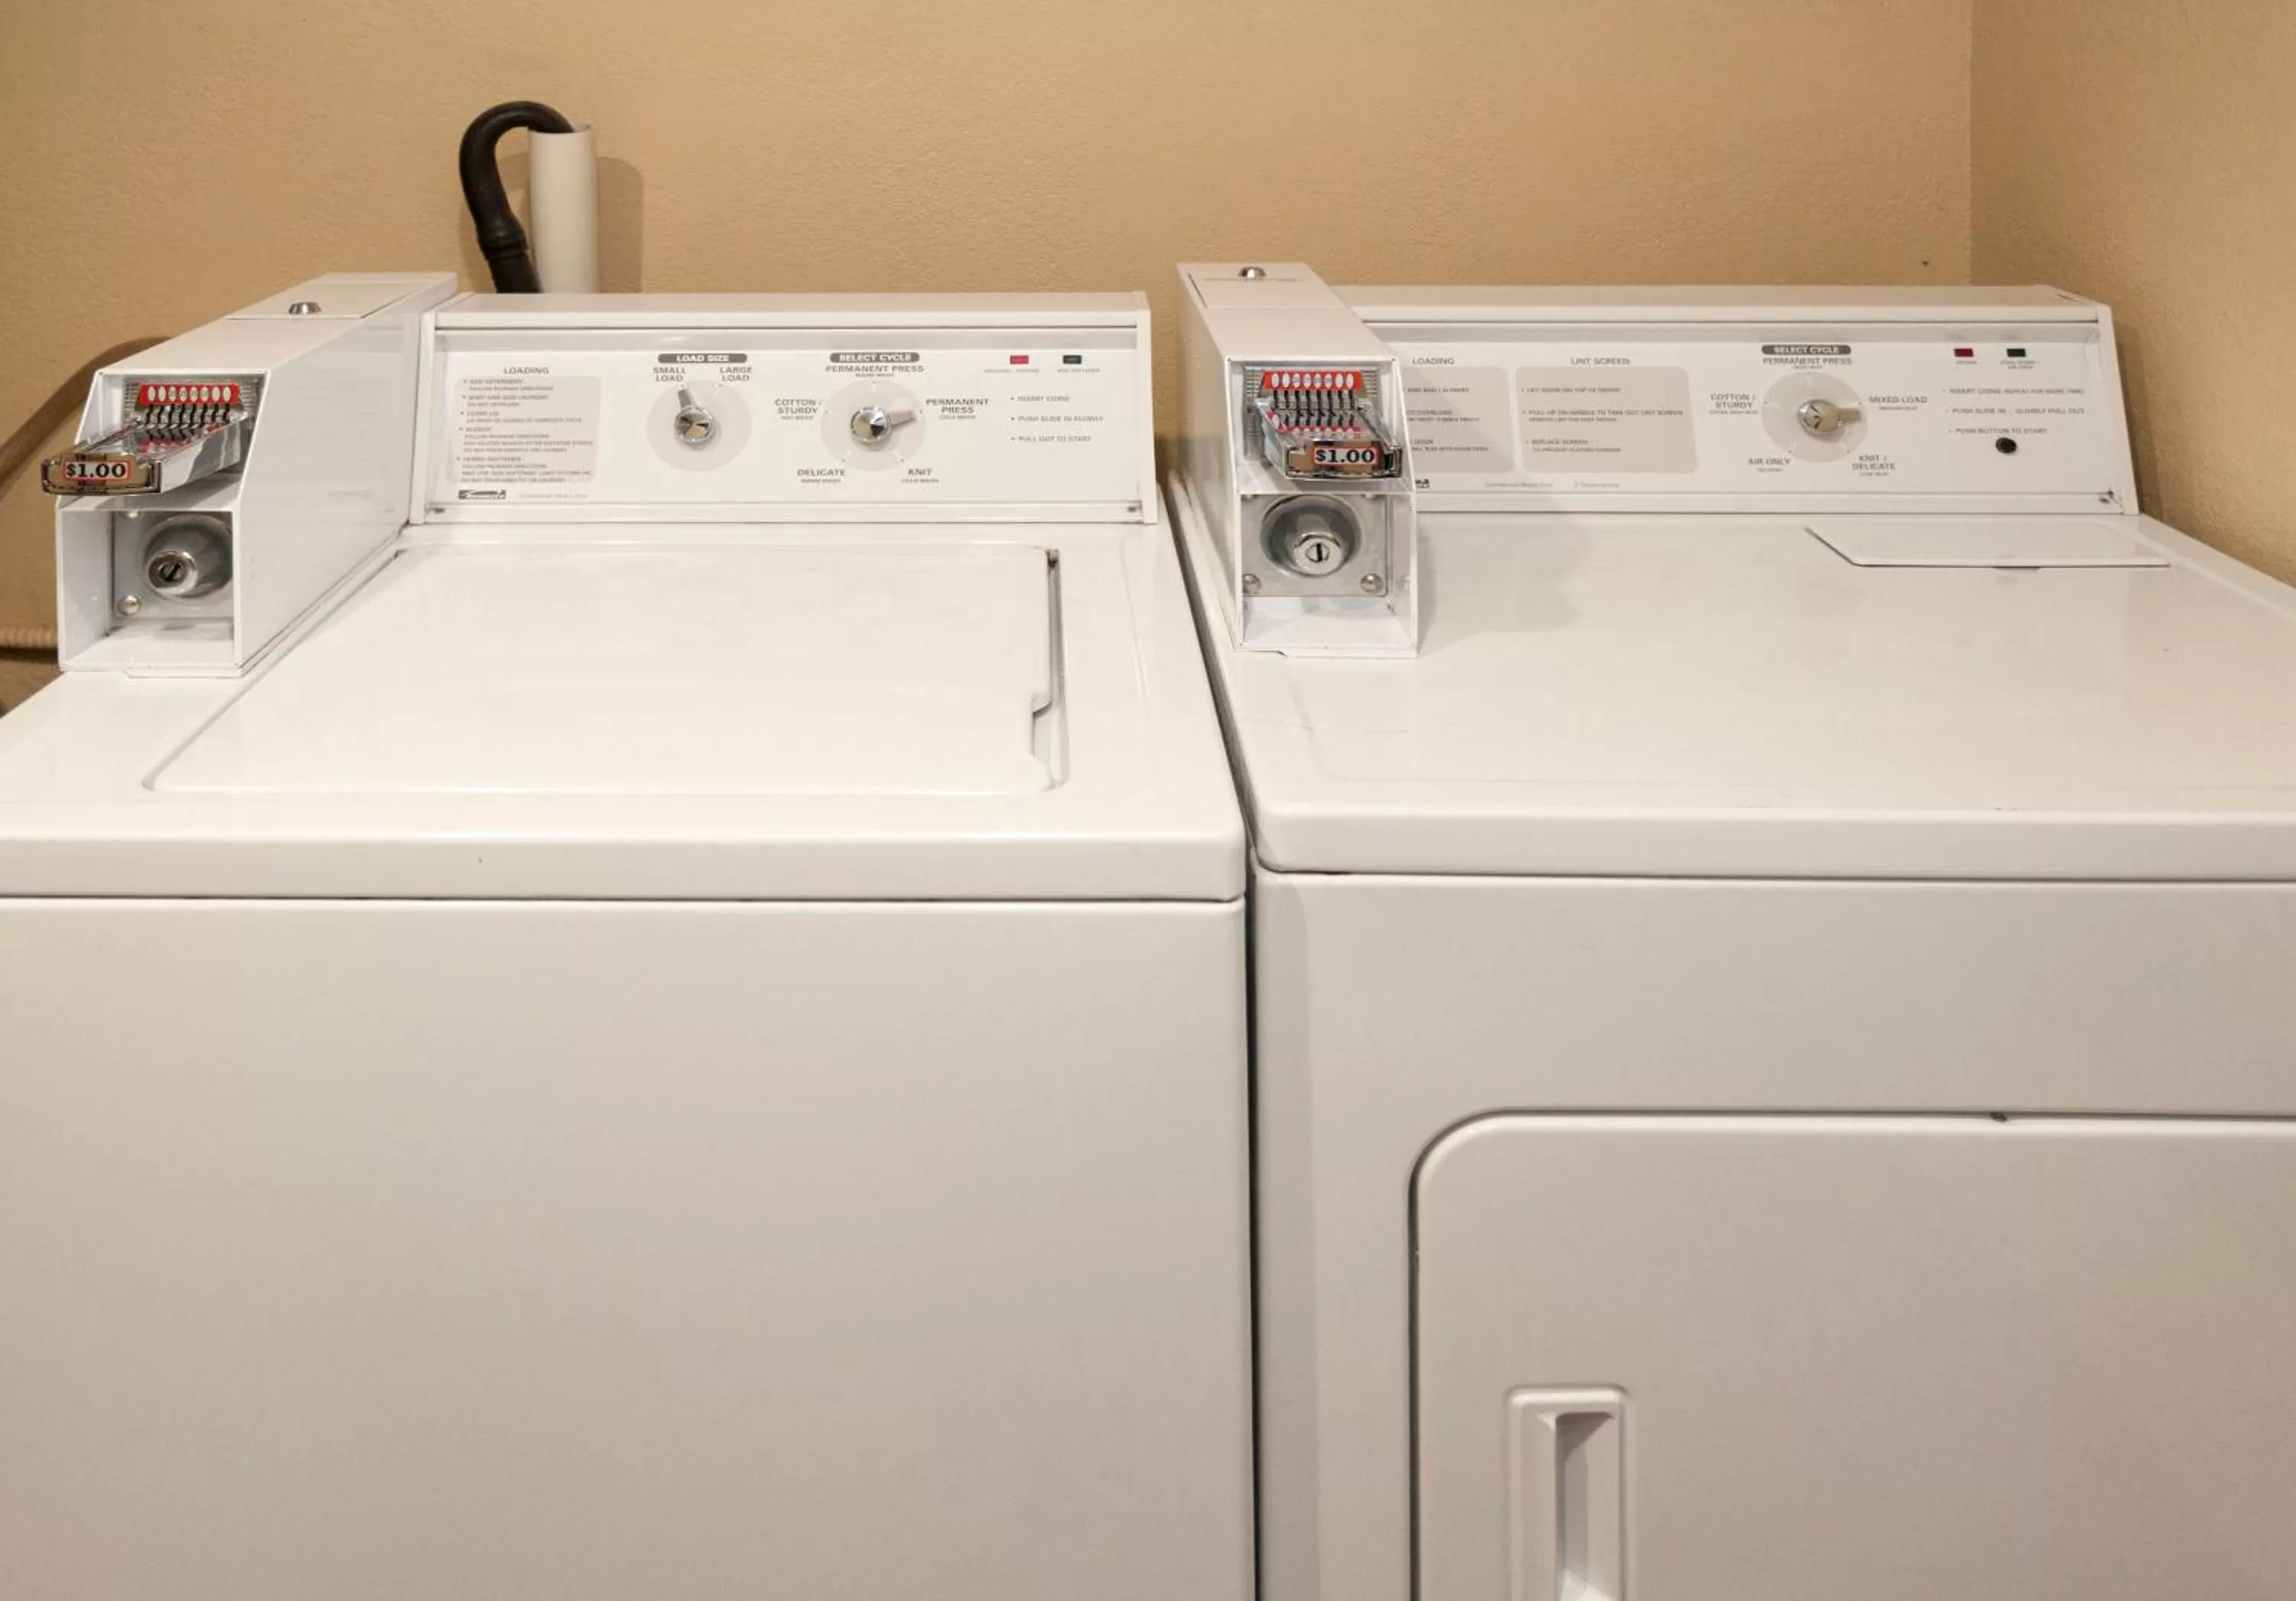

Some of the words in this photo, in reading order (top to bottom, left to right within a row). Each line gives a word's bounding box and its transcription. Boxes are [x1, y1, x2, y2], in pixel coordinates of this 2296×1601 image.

[839, 354, 877, 362] SELECT
[879, 354, 912, 362] CYCLE
[774, 398, 817, 406] COTTON
[1316, 449, 1375, 463] $1.00
[1747, 458, 1763, 466] AIR
[1766, 458, 1792, 466] ONLY
[67, 463, 126, 478] $1.00
